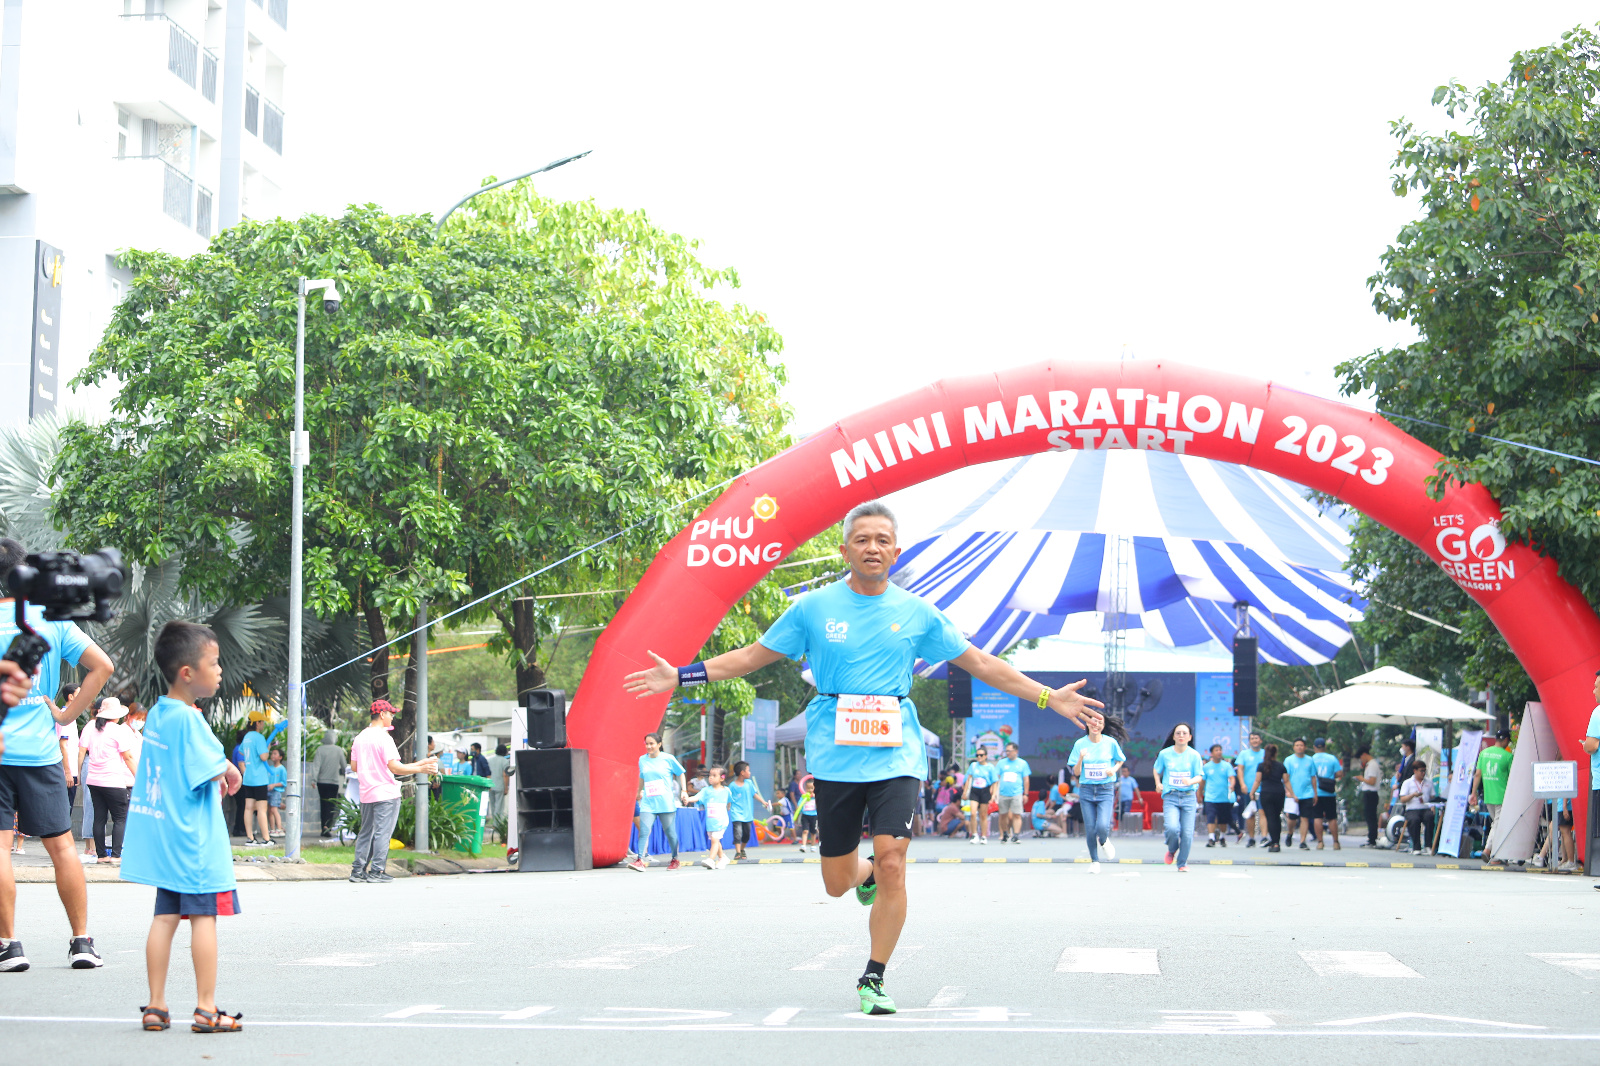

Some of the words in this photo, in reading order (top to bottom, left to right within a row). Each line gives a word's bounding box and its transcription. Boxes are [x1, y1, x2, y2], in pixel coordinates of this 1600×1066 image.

[830, 411, 952, 488] MINI
[963, 388, 1265, 444] MARATHON
[1274, 415, 1396, 485] 2023
[691, 516, 754, 541] PHU
[1433, 514, 1464, 526] LET'S
[1436, 524, 1506, 562] GO
[686, 542, 783, 568] DONG
[55, 574, 89, 586] RONIN
[1440, 560, 1515, 581] GREEN
[825, 621, 849, 634] GO
[850, 719, 889, 735] 0086
